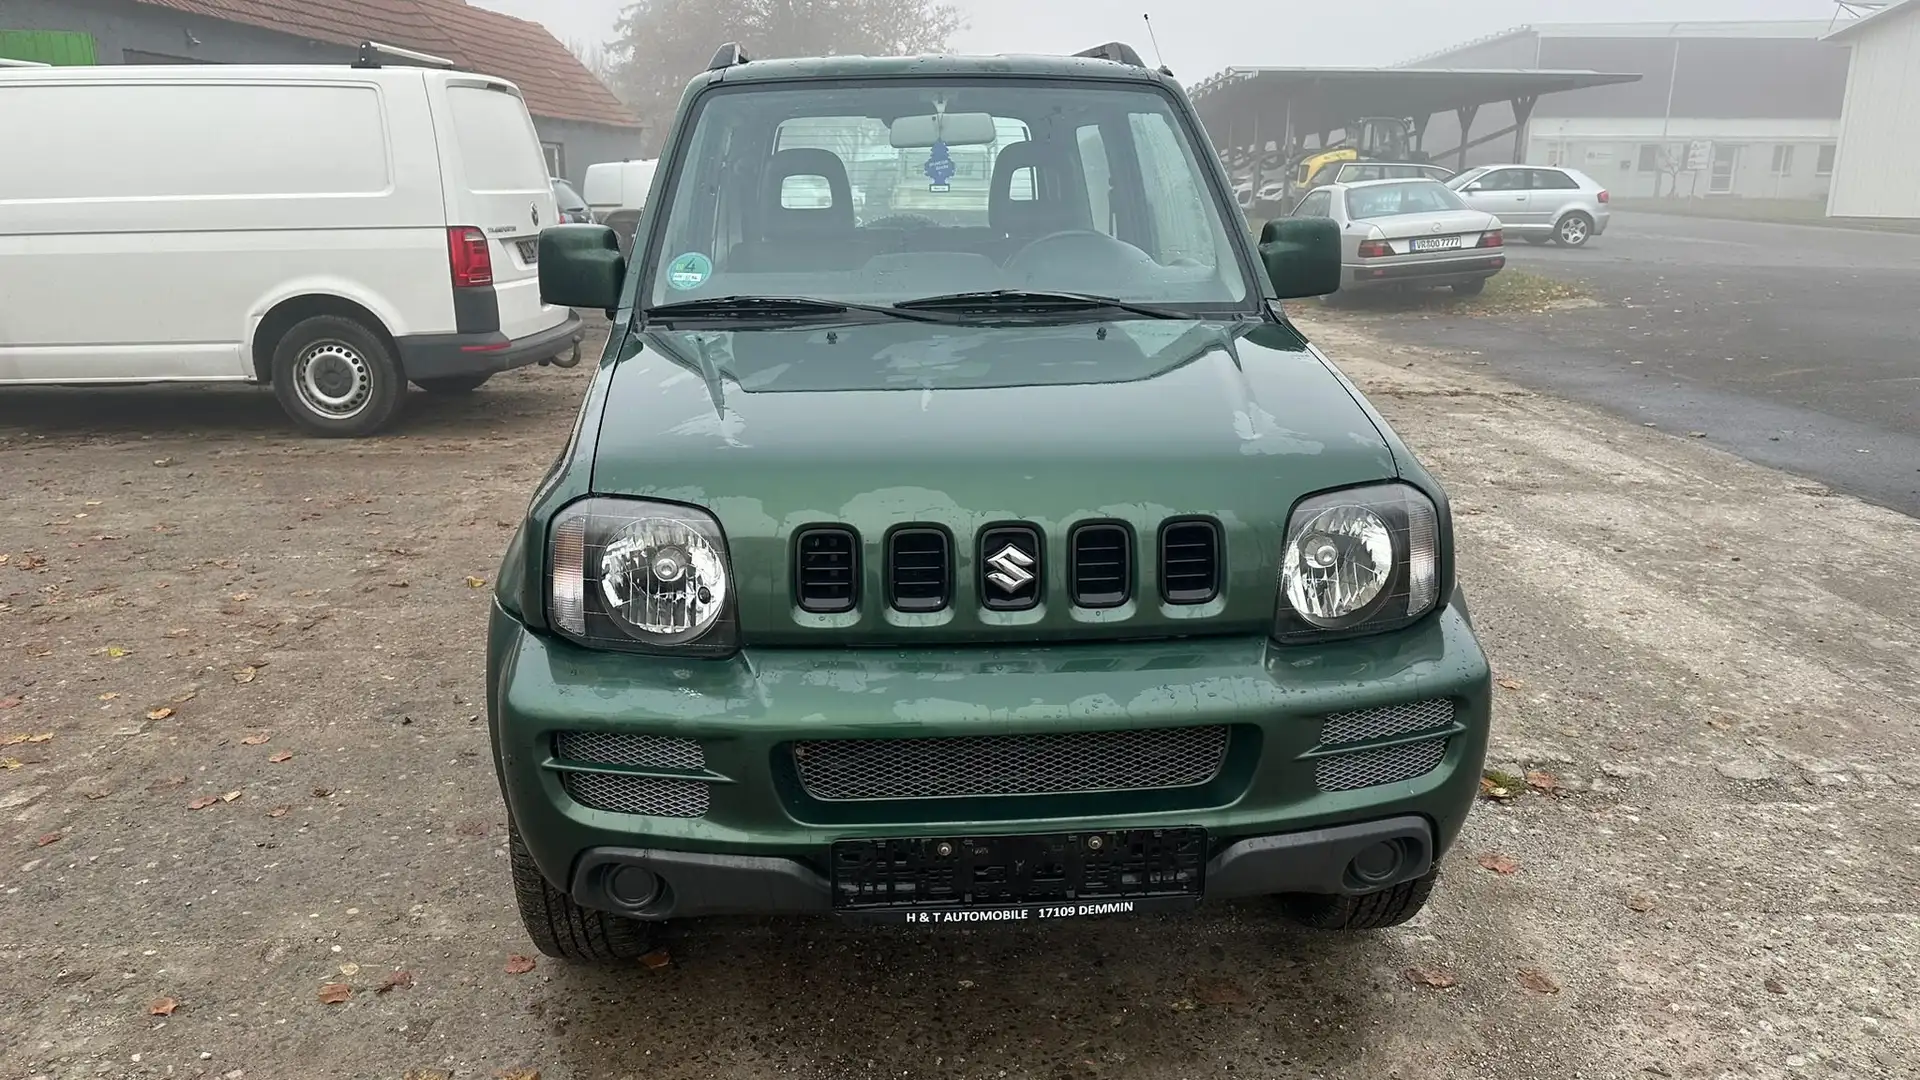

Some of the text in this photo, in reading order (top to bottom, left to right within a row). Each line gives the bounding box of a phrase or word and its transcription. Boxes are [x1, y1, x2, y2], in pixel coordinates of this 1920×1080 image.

[1441, 237, 1459, 246] 7777
[684, 257, 696, 272] 4
[906, 902, 1134, 923] H & T AUTOMOBILE 17109 DEMMIN
